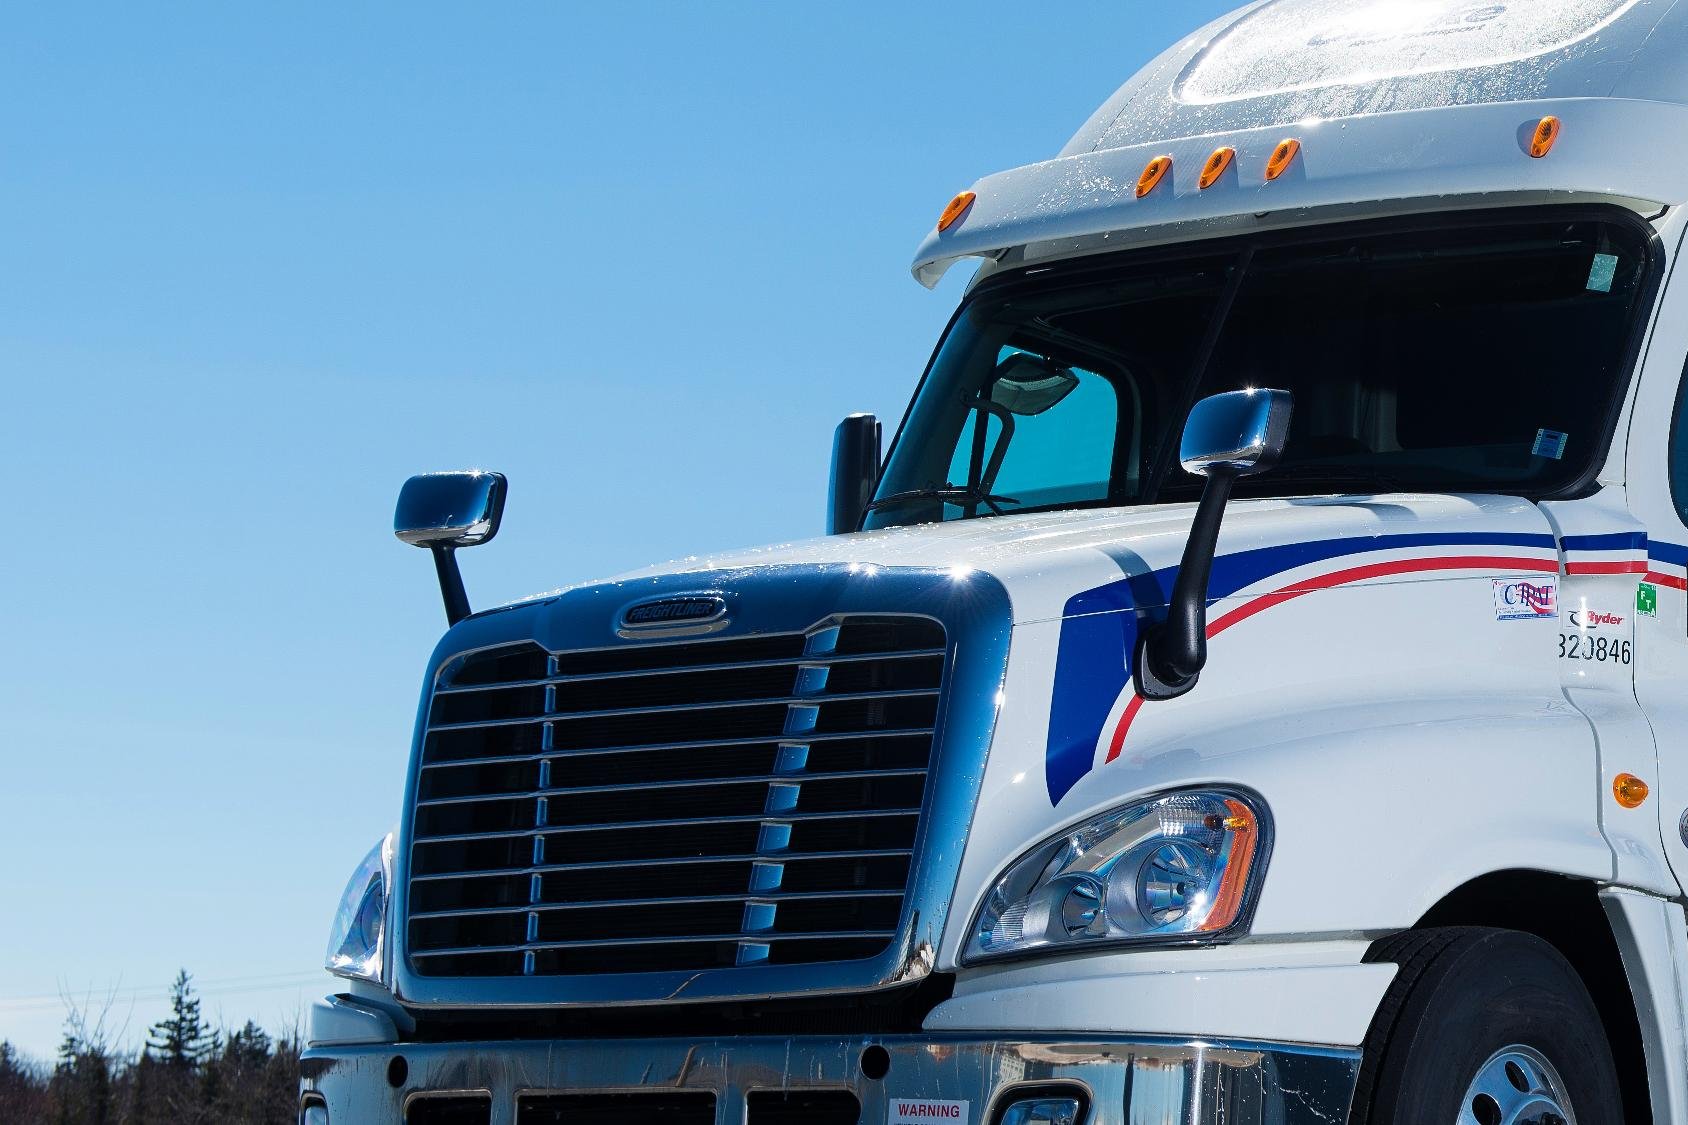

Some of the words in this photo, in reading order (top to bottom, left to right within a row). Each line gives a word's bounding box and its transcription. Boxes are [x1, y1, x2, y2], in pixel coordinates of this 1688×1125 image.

[629, 602, 713, 621] FREIGHTLINER
[1587, 610, 1624, 625] Ryder
[898, 1103, 960, 1118] WARNING
